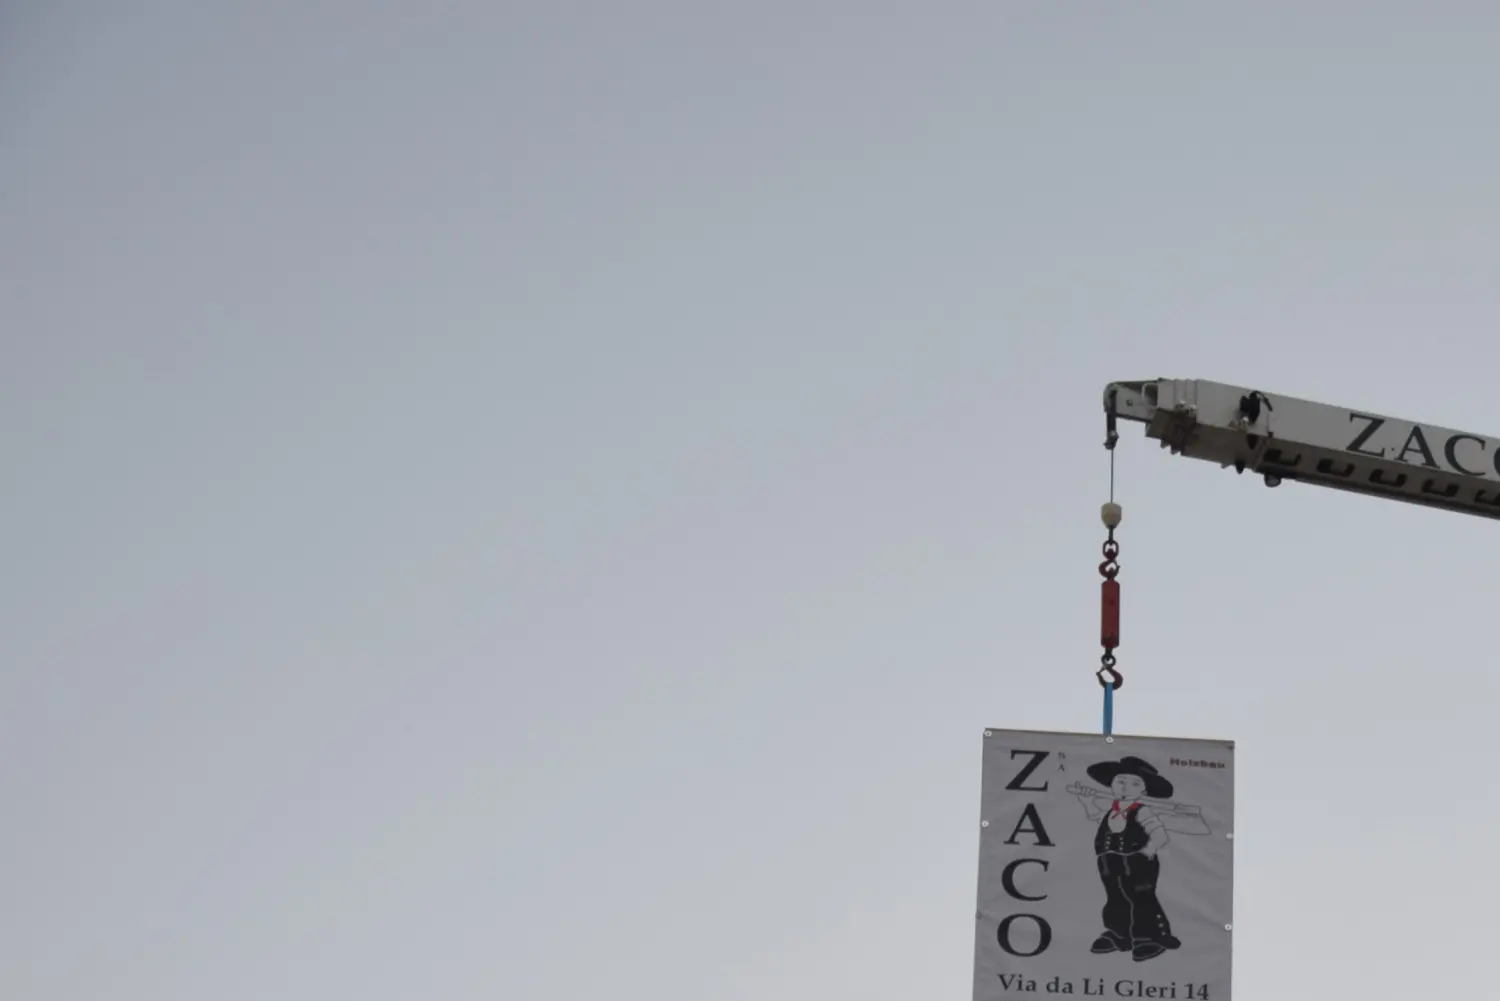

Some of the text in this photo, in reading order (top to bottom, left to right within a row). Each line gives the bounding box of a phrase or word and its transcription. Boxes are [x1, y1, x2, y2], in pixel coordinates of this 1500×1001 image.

[997, 973, 1209, 1001] Via da Li Gleri 14
